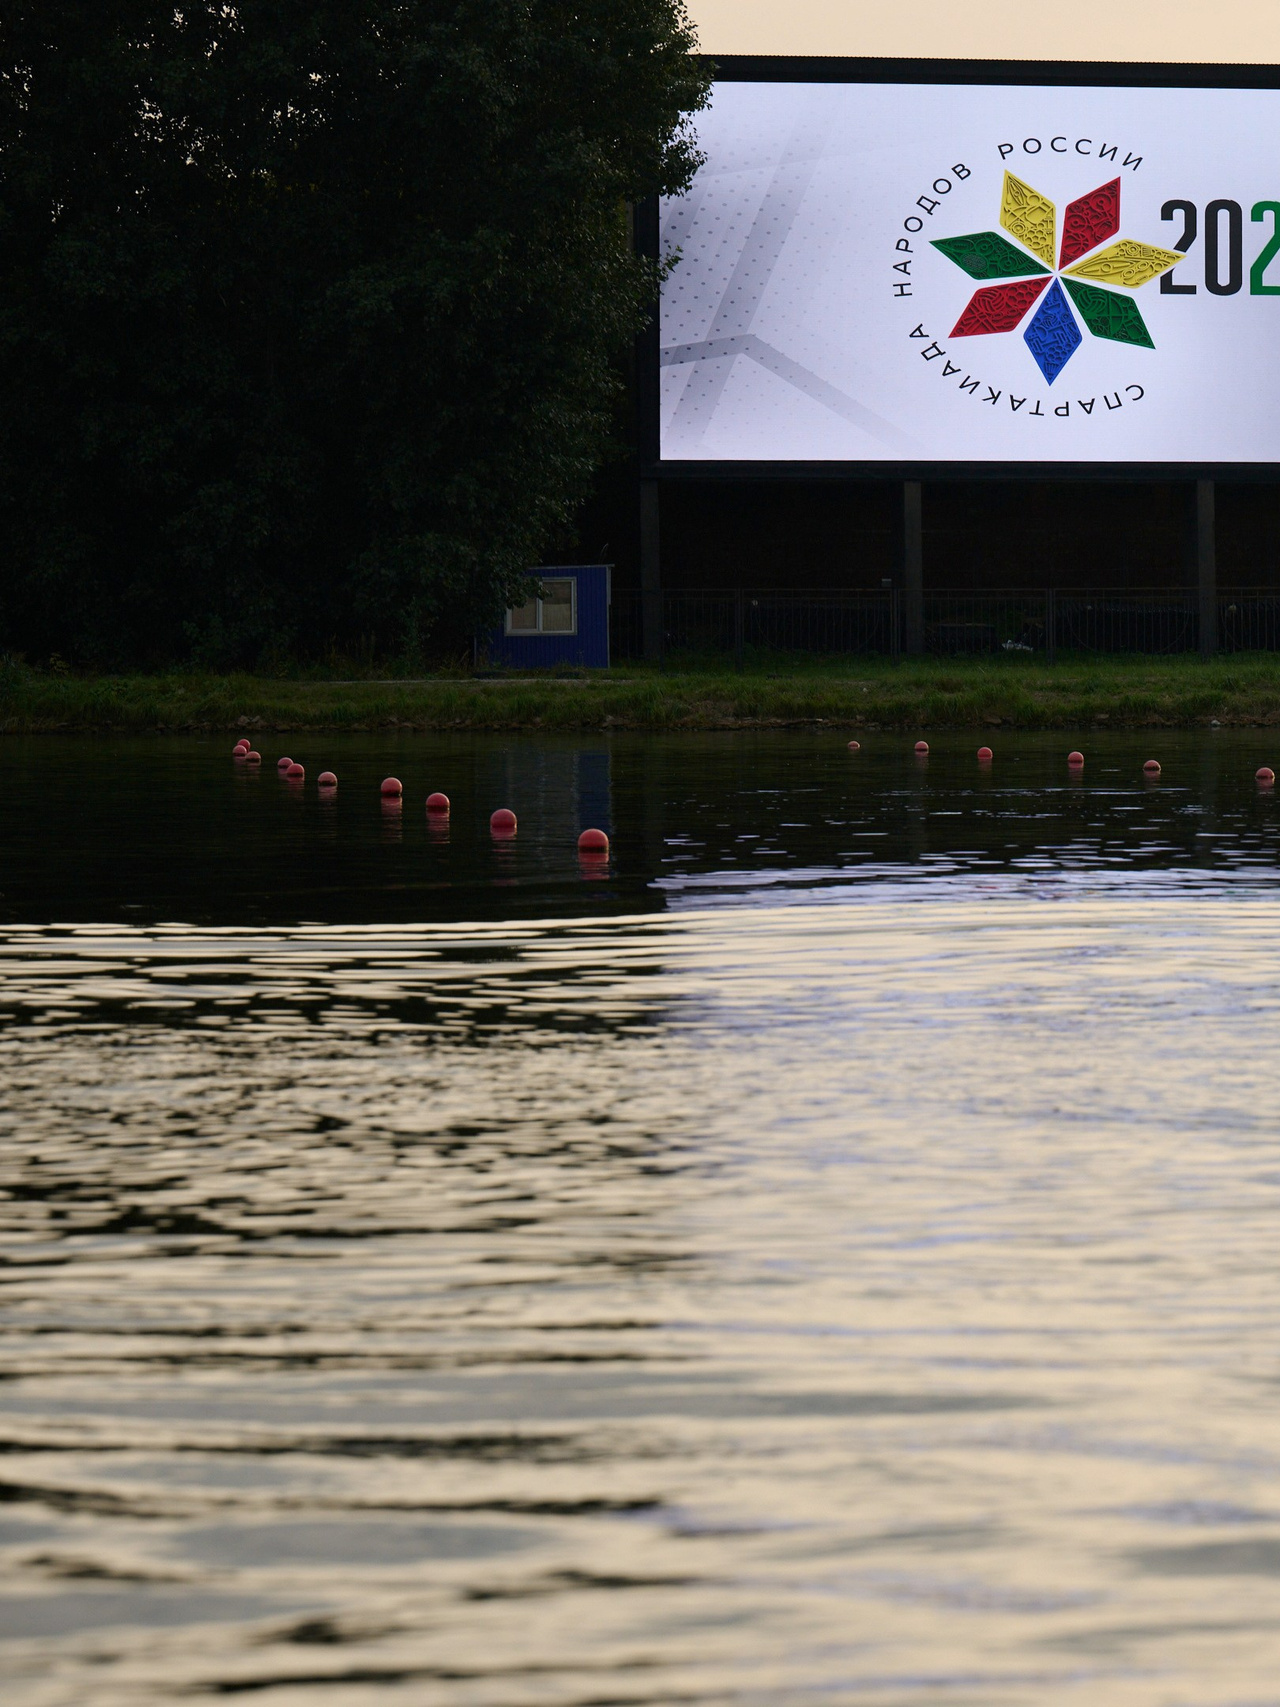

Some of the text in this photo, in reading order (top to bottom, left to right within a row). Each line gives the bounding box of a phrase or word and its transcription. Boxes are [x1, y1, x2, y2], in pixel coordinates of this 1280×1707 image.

[893, 136, 1145, 417] СПАРТАКИАДА НАРОДОВ РОССИИ
